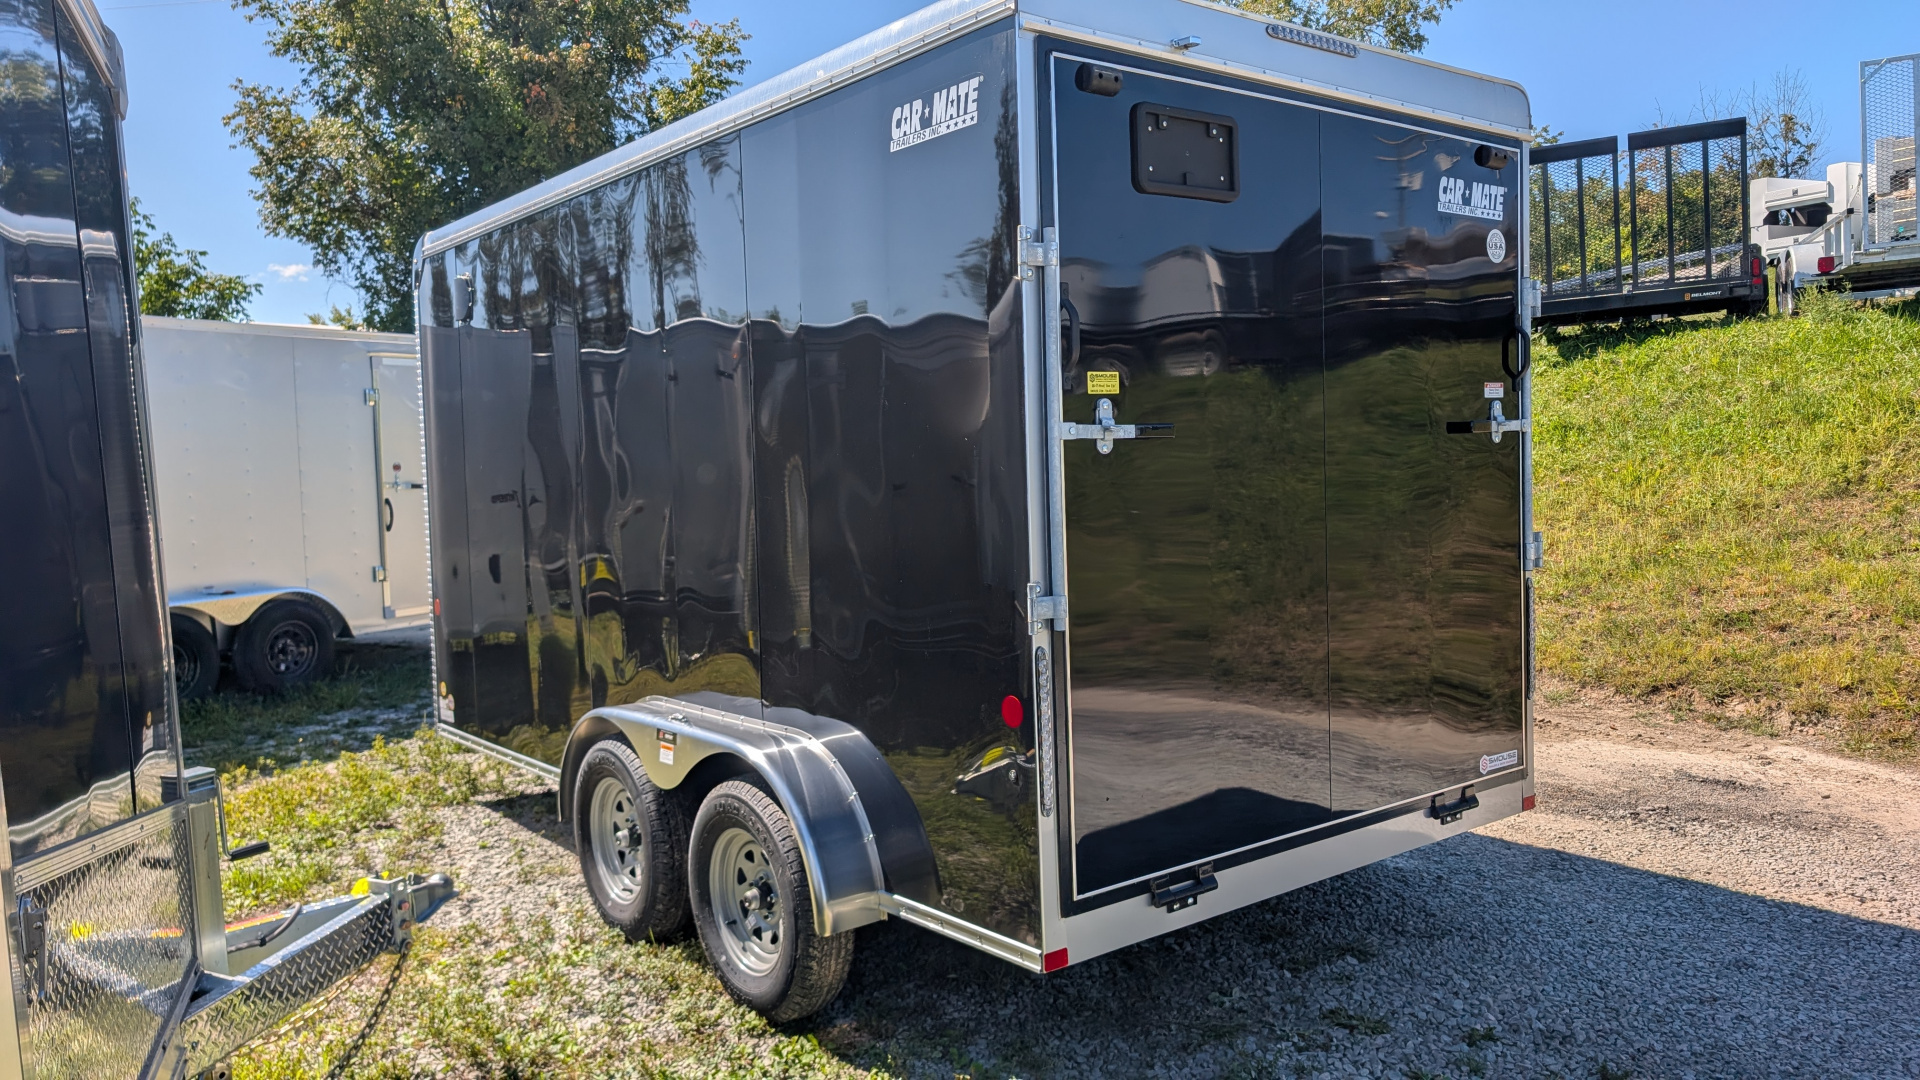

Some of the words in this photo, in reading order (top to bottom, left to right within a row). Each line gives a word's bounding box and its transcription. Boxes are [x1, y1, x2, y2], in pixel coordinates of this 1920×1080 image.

[891, 99, 923, 140] CAR
[932, 76, 980, 126] MATE
[891, 130, 927, 151] TRAILERS
[928, 125, 944, 138] INC.
[1438, 176, 1465, 205] CAR
[1470, 181, 1505, 212] MATE
[1438, 202, 1467, 214] TRAILERS
[1467, 207, 1480, 216] INC.
[1488, 242, 1504, 250] USA
[1691, 290, 1722, 298] BELMONT
[1488, 751, 1517, 765] SMOUSE
